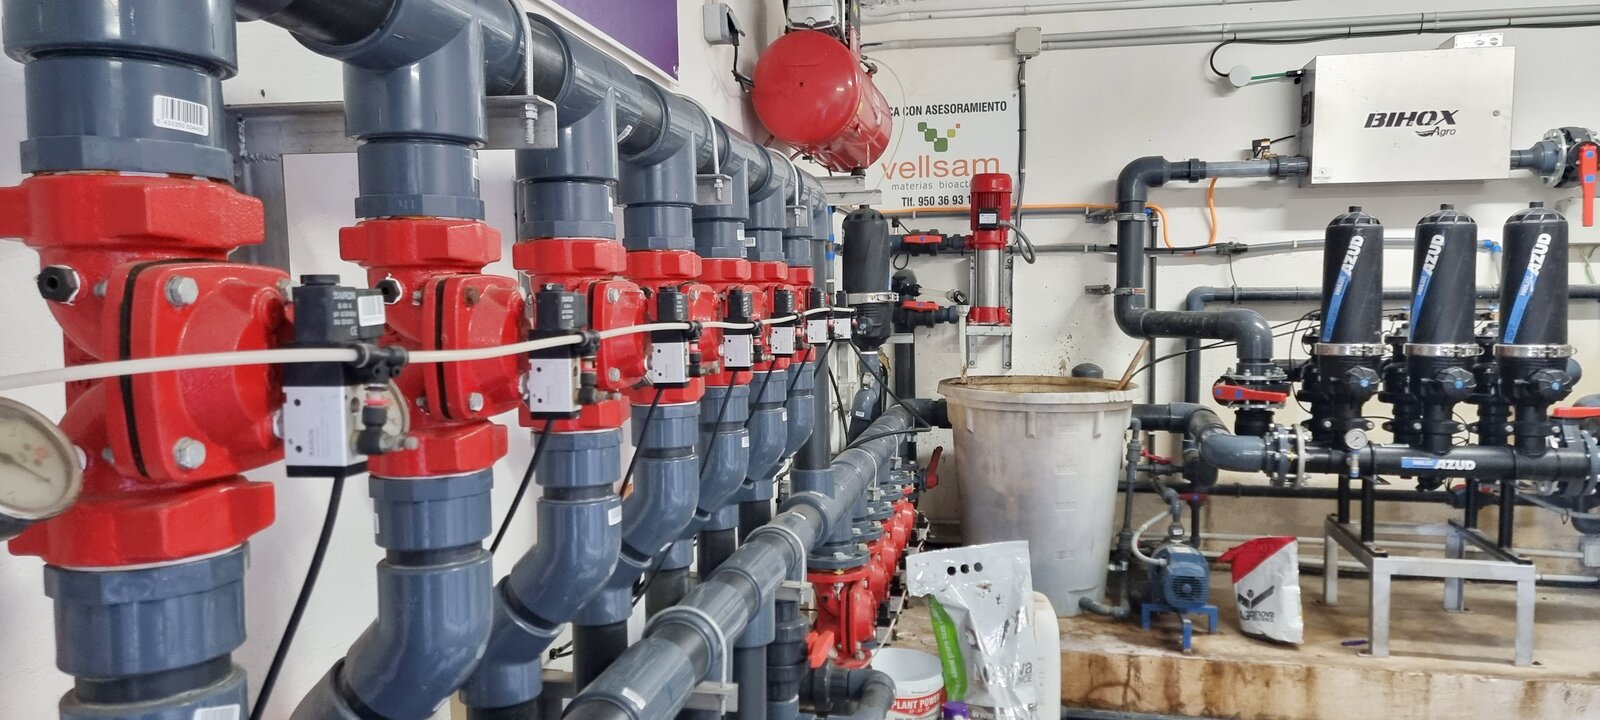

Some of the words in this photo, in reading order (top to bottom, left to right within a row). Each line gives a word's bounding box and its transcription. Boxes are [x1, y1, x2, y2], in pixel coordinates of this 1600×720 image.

[903, 105, 922, 116] CON
[925, 101, 1007, 115] ASESORAMIENTO
[1431, 126, 1457, 137] Agro
[881, 155, 1000, 180] vellsam
[891, 180, 933, 191] materias
[918, 196, 935, 206] 950
[938, 195, 949, 205] 36
[952, 195, 964, 205] 93
[1341, 235, 1365, 279] AZUD
[1423, 234, 1446, 276] AZUD
[1527, 233, 1552, 276] AZUD
[1434, 460, 1476, 470] AZUD
